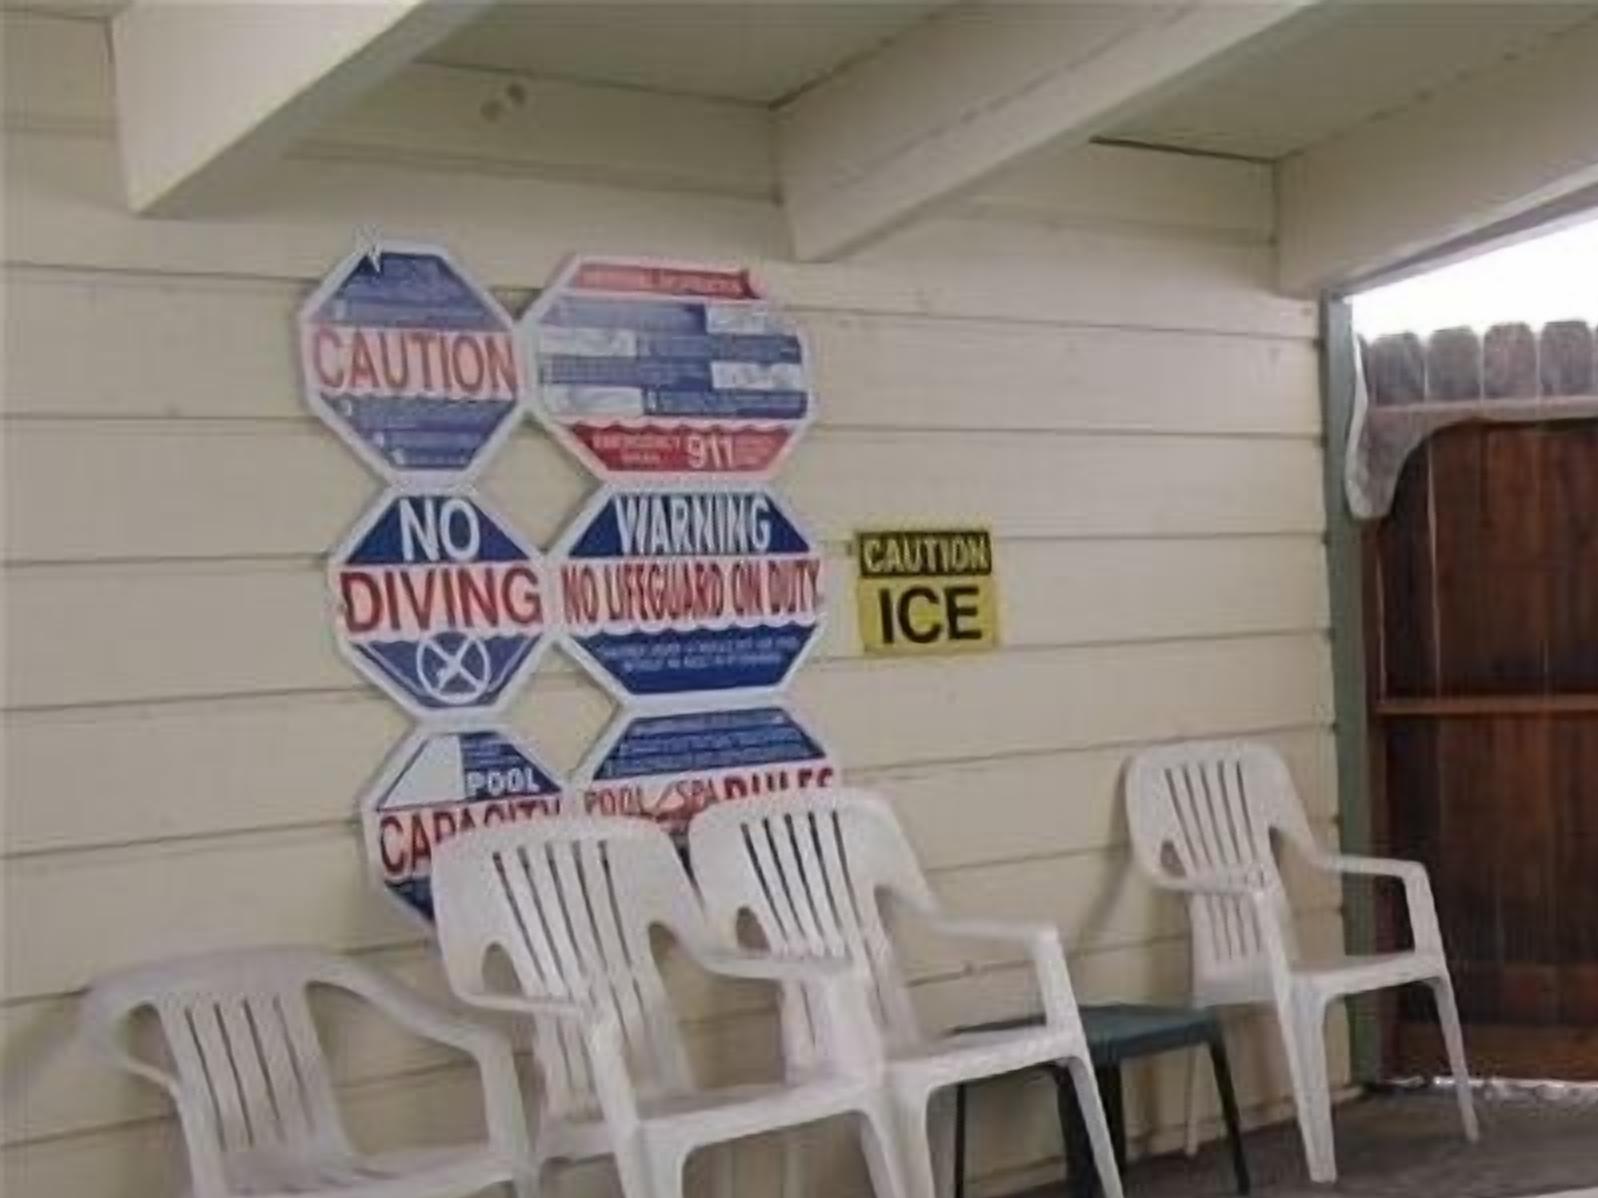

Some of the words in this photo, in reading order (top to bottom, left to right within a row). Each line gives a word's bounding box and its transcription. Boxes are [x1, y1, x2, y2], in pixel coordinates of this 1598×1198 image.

[313, 326, 518, 394] CAUTION
[686, 432, 732, 468] 911
[400, 498, 480, 561] NO
[614, 495, 770, 555] WARNING
[863, 535, 989, 573] CAUTION
[340, 565, 544, 633] DIVING
[561, 563, 600, 622] NO
[604, 561, 724, 621] LIFEGUARD
[731, 560, 763, 614] ON
[767, 558, 820, 612] DUTY
[879, 586, 982, 644] ICE
[466, 766, 540, 796] POOL
